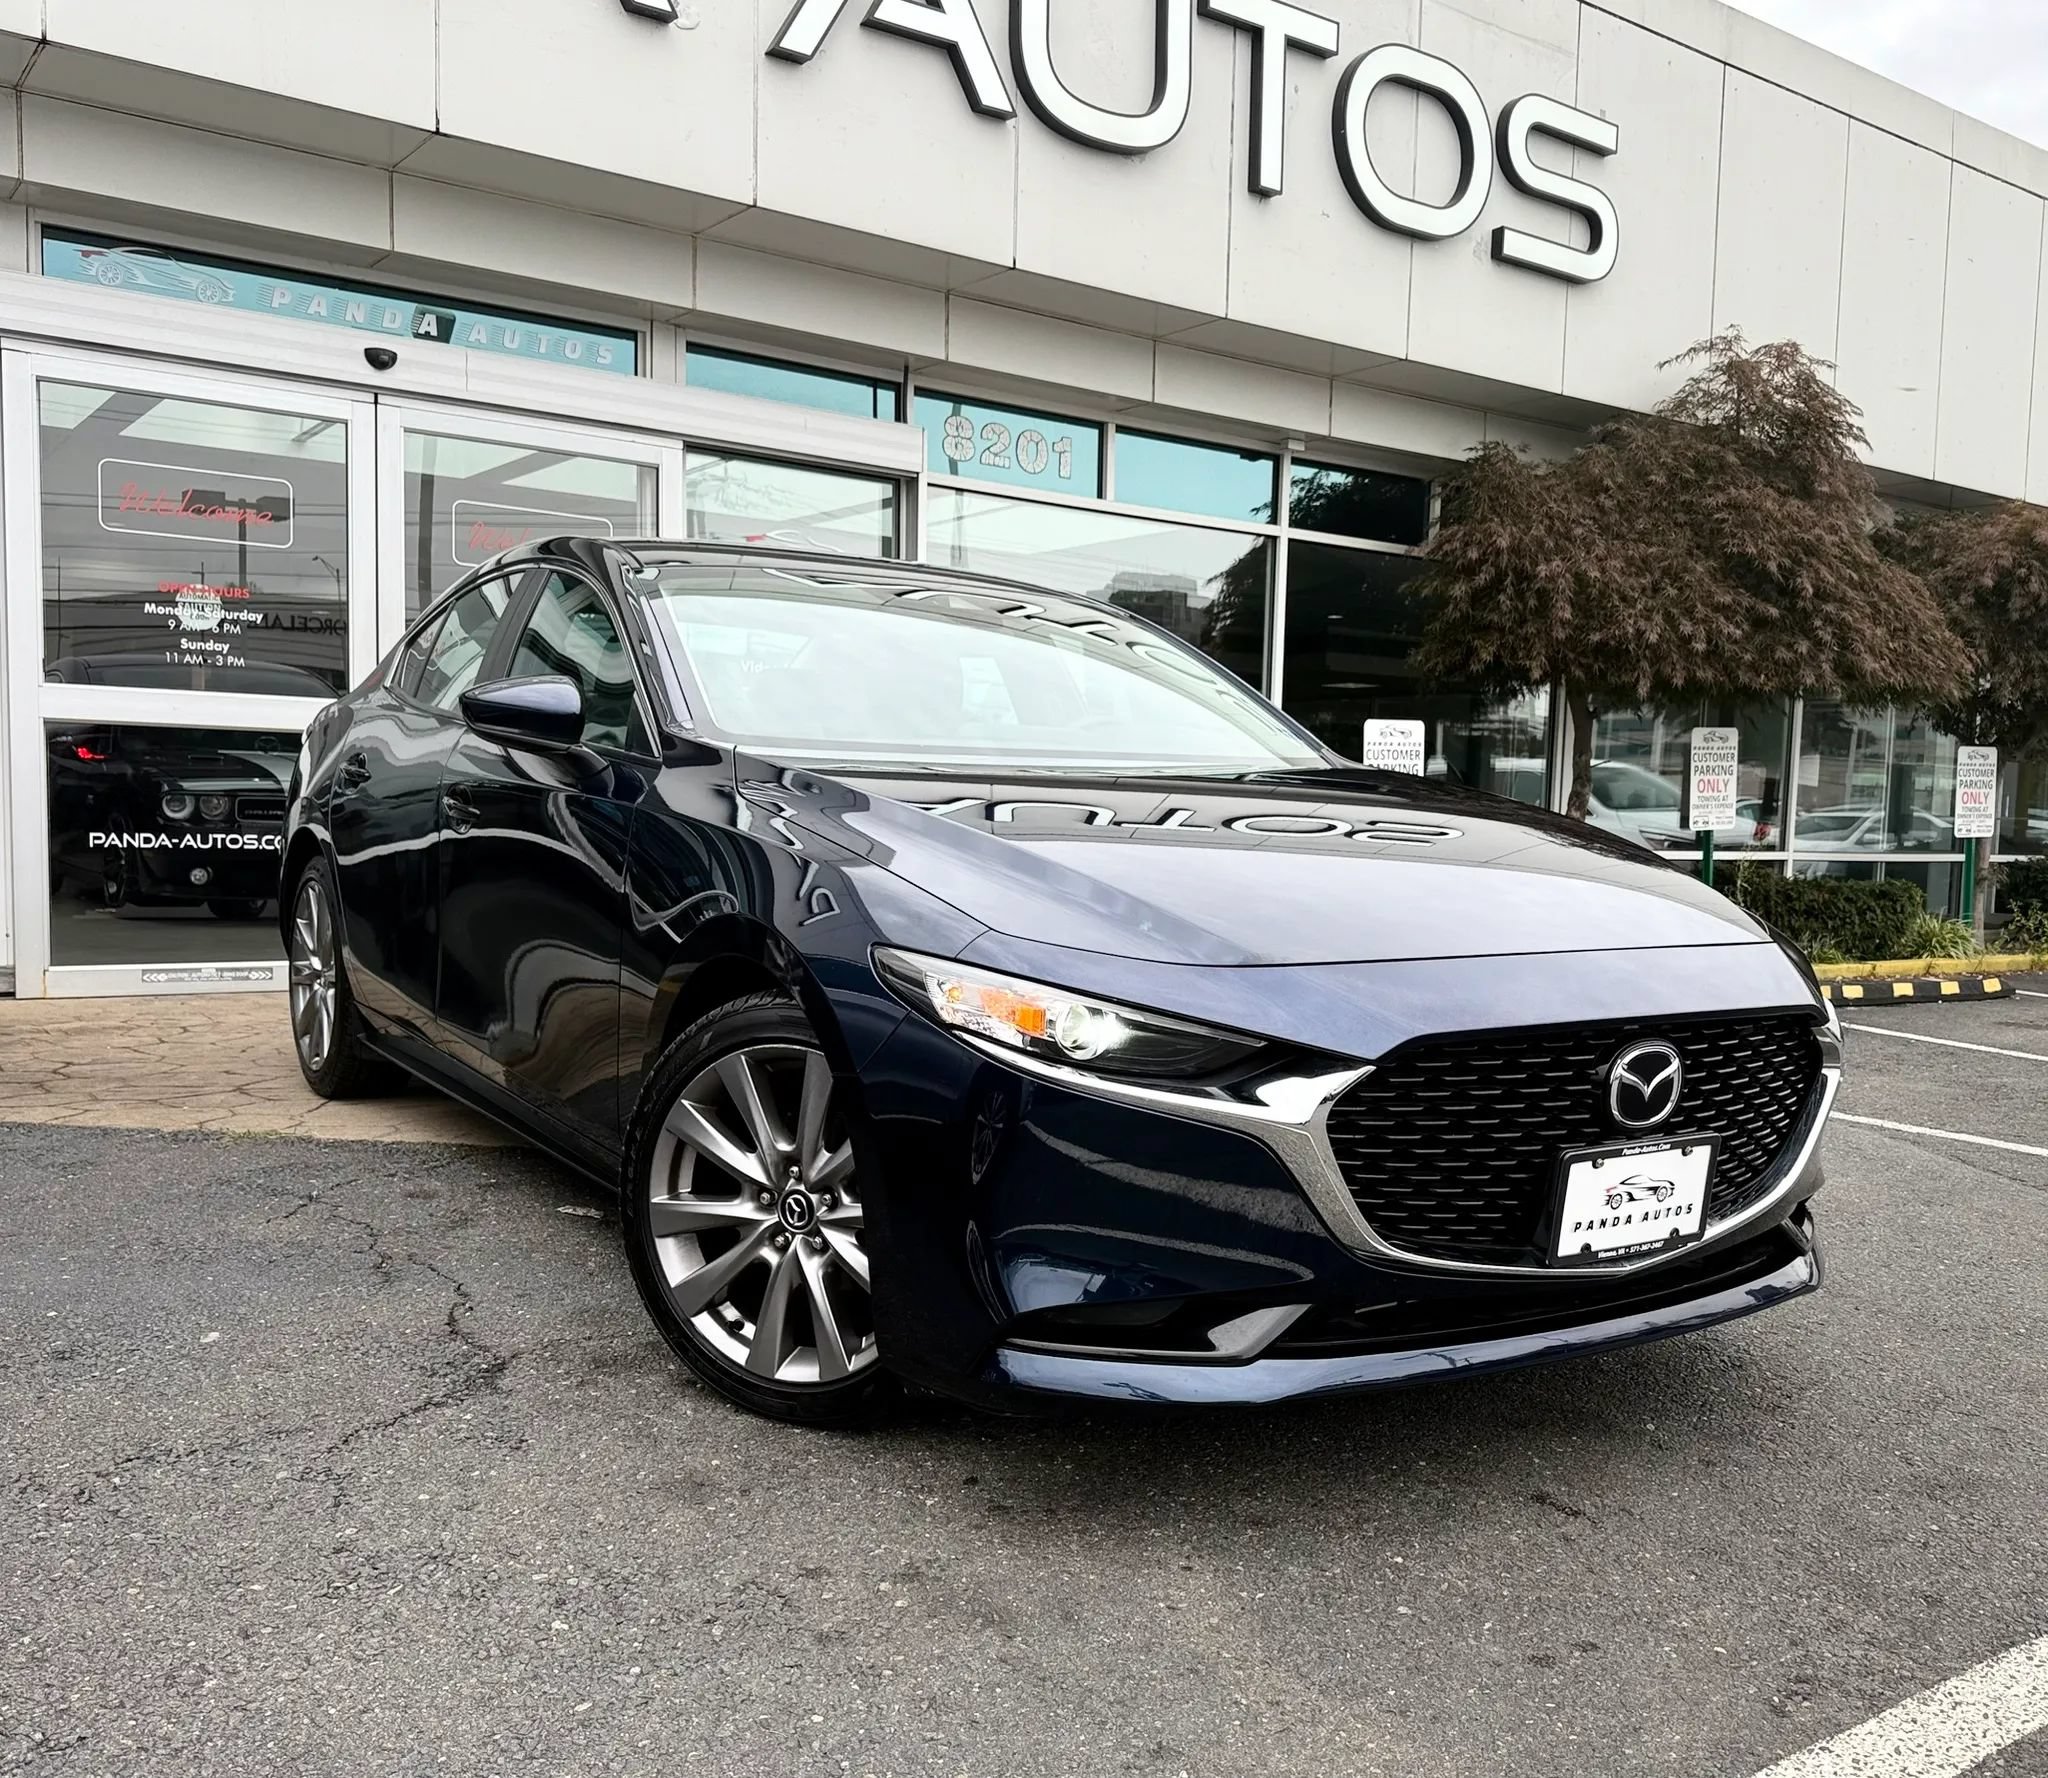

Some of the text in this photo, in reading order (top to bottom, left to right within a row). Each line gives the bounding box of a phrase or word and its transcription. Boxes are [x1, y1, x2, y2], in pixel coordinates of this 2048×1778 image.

[270, 286, 615, 365] PANDA AUTOS
[942, 415, 1072, 480] 8201
[119, 481, 273, 525] Welcome
[168, 619, 176, 630] 9
[212, 624, 220, 634] 6
[223, 623, 241, 634] PM
[180, 638, 230, 654] Sunday
[165, 652, 179, 663] 11
[183, 654, 204, 665] AM
[215, 655, 223, 666] 3
[227, 656, 245, 668] PM
[1366, 749, 1421, 761] CUSTOMER
[1692, 752, 1735, 763] CUSTOMER
[1693, 765, 1734, 776] PARKING
[1958, 768, 1995, 778] CUSTOMER
[1697, 778, 1730, 793] ONLY
[1959, 780, 1993, 790] PARKING
[1961, 791, 1990, 805] ONLY
[1573, 1203, 1694, 1233] PANDA AUTOS
